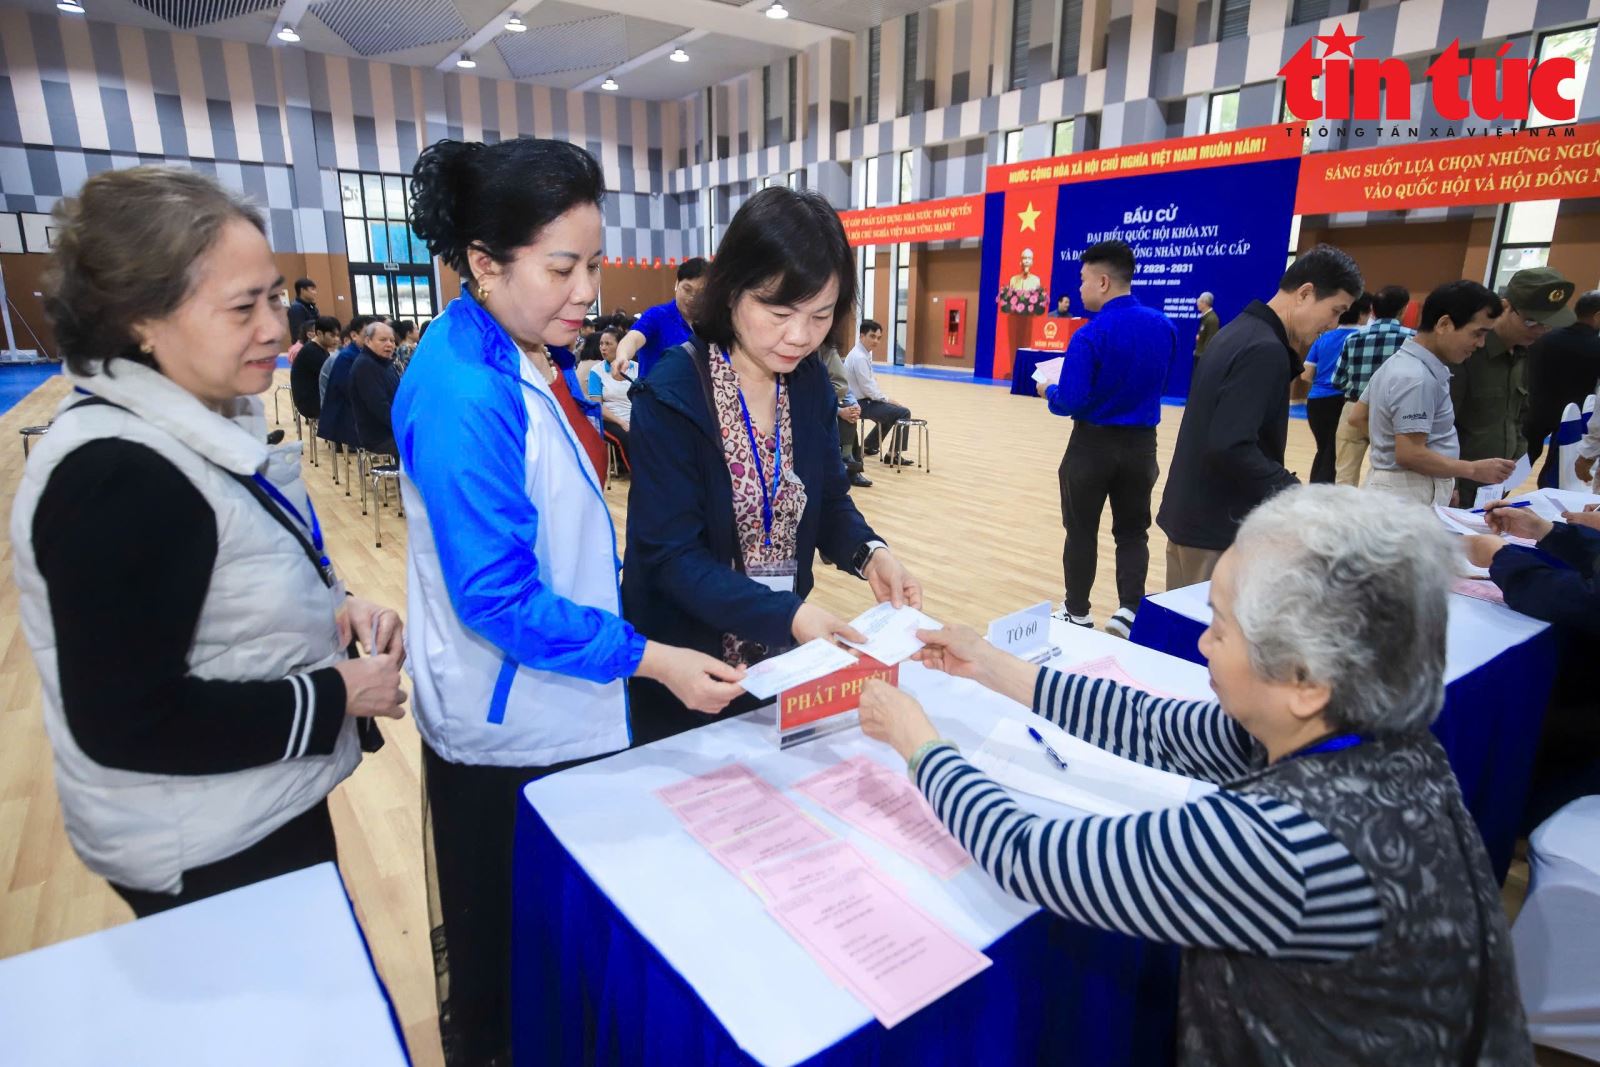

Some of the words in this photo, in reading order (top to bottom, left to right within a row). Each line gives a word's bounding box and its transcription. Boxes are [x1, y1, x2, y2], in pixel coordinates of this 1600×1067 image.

[1031, 165, 1052, 182] CỘNG
[1084, 158, 1100, 175] HỘI
[1100, 153, 1120, 172] CHỦ
[1120, 150, 1149, 169] NGHĨA
[1151, 148, 1172, 168] VIỆT
[1173, 146, 1198, 163] NAM
[1199, 140, 1232, 160] MUÔN
[1324, 164, 1361, 181] SÁNG
[1363, 156, 1402, 177] SUỐT
[1404, 157, 1435, 177] LỰA
[1438, 153, 1485, 173] CHỌN
[1487, 146, 1551, 167] NHỮNG
[1363, 181, 1393, 199] VÀO
[1395, 175, 1438, 200] QUỐC
[1440, 175, 1472, 197] HỘI
[1474, 172, 1496, 192] VÀ
[1499, 170, 1532, 192] HỘI
[1535, 164, 1589, 188] ĐỒNG
[933, 206, 950, 219] PHÁP
[1155, 203, 1179, 223] CỬ
[1086, 231, 1102, 246] ĐẠI
[1125, 224, 1151, 243] QUỐC
[1152, 224, 1170, 242] HỘI
[1171, 223, 1200, 239] KHÓA
[1200, 225, 1219, 238] XVI
[1131, 242, 1153, 258] ỒNG
[1154, 242, 1182, 258] NHÂN
[1183, 241, 1205, 257] DÂN
[1206, 240, 1227, 256] CÁC
[1228, 238, 1251, 255] CẤP
[1170, 263, 1193, 274] 2031
[1025, 620, 1038, 637] 60
[786, 684, 837, 714] PHÁT
